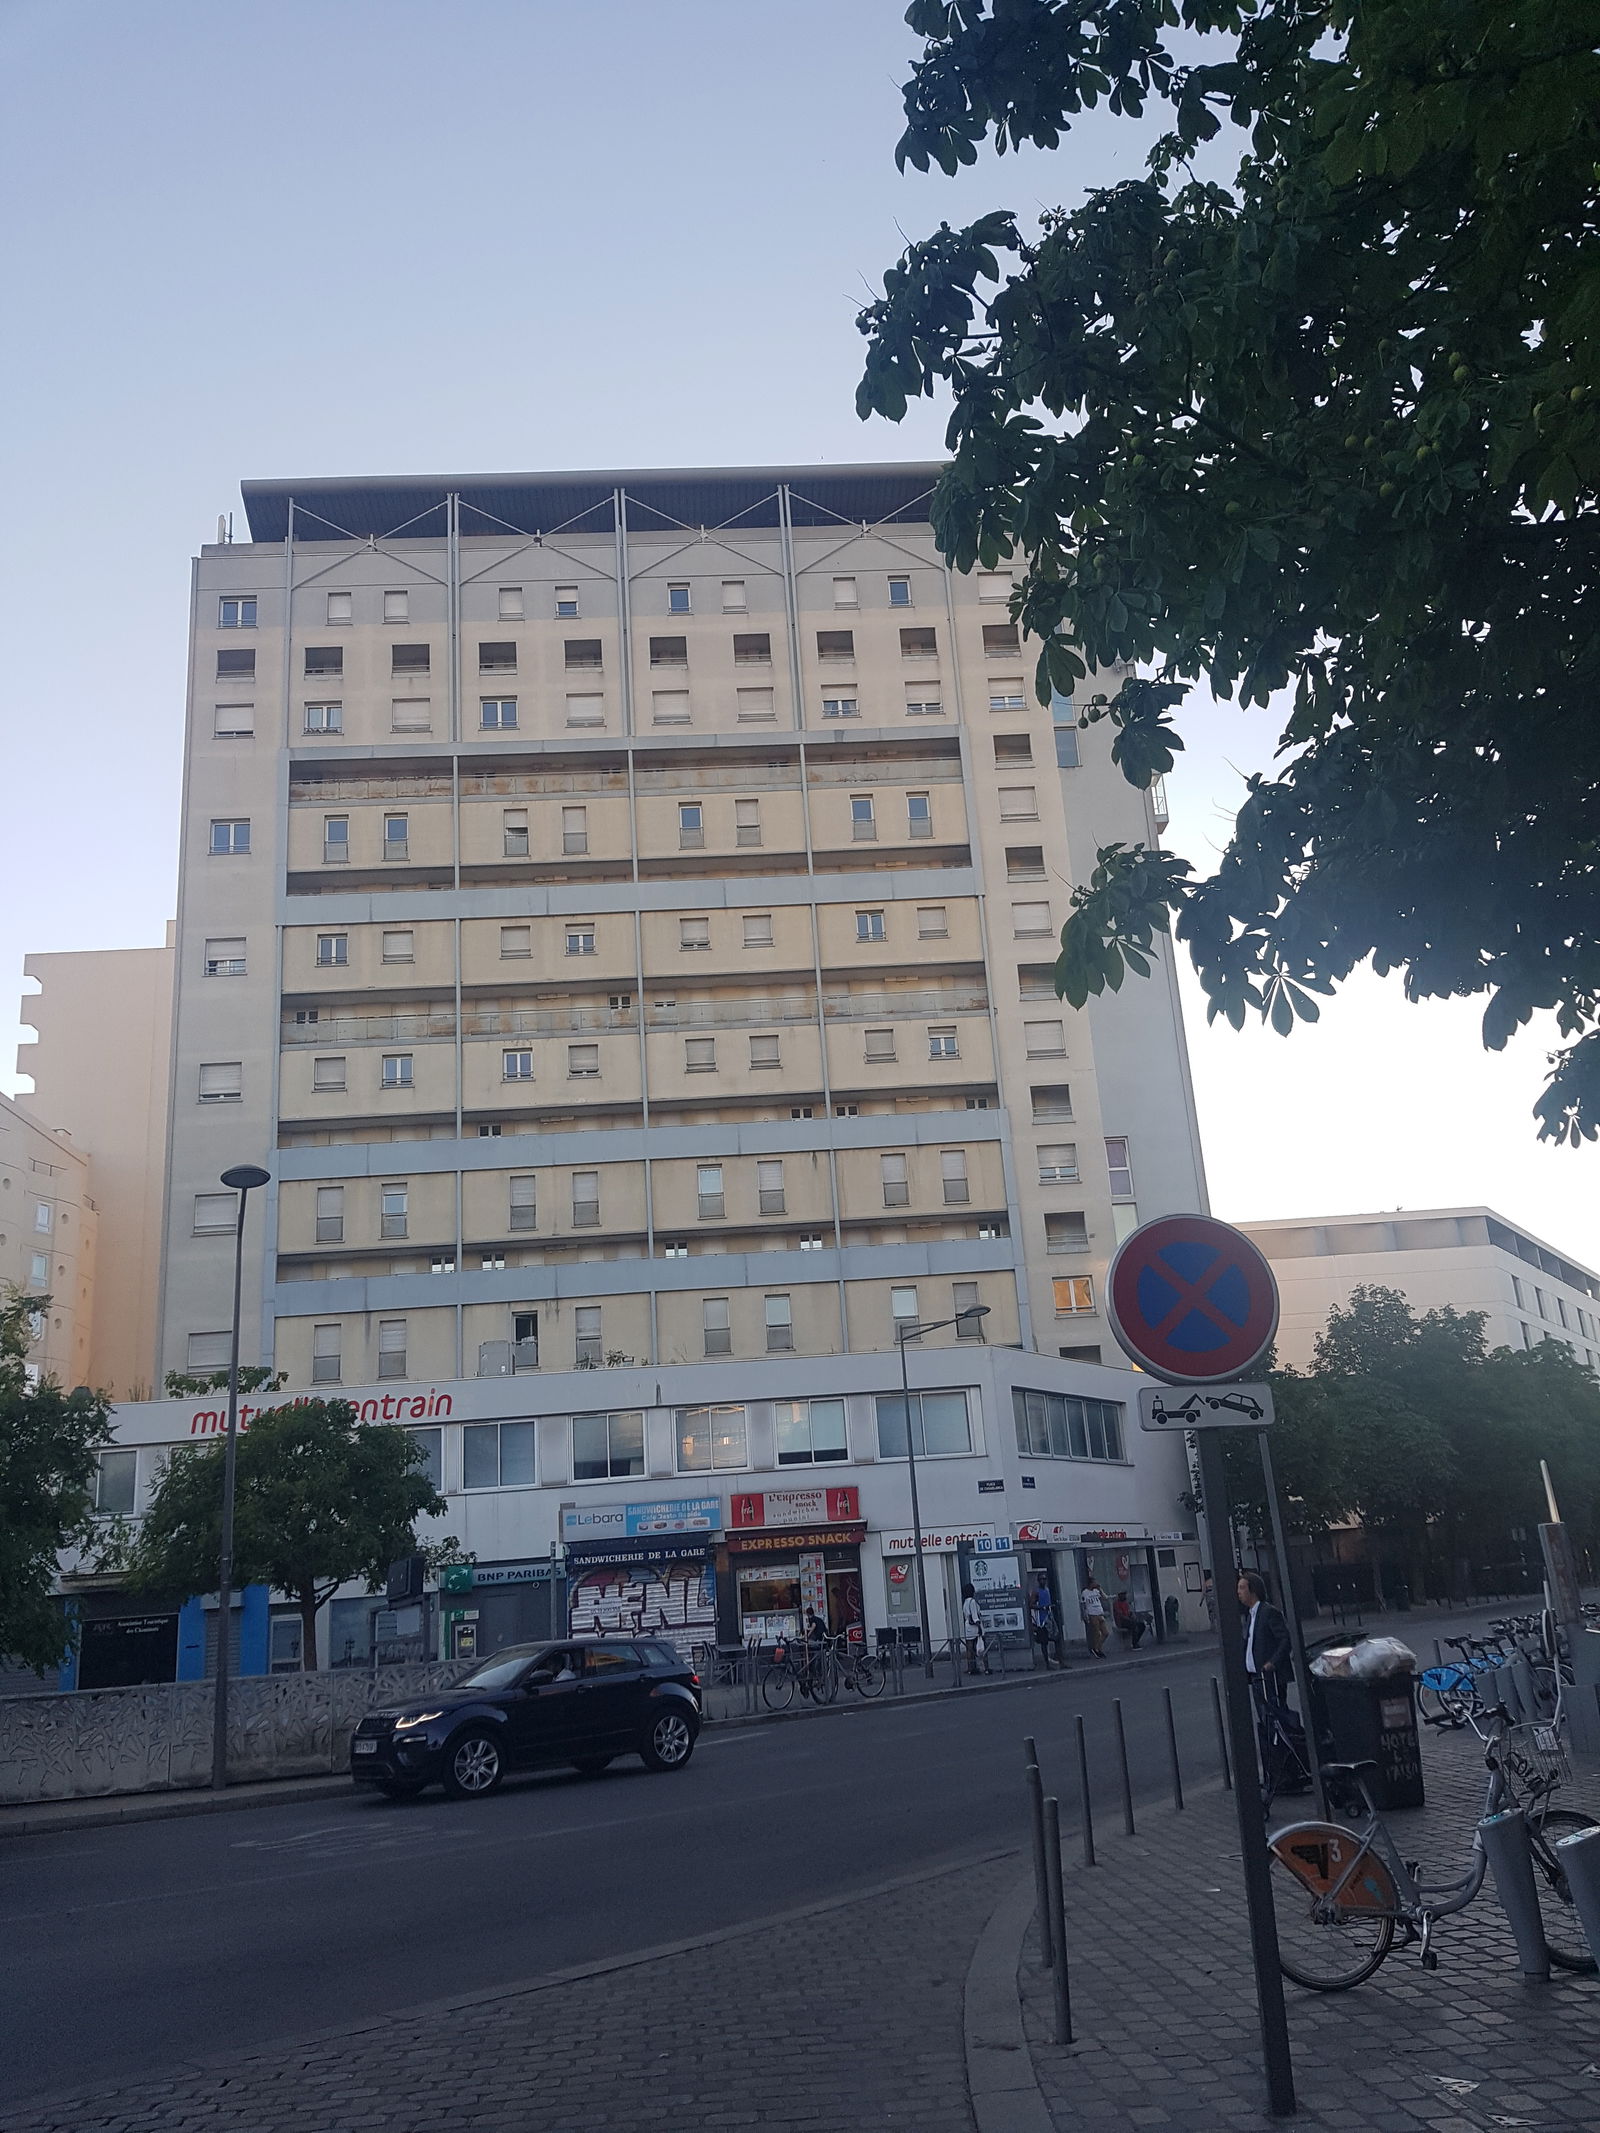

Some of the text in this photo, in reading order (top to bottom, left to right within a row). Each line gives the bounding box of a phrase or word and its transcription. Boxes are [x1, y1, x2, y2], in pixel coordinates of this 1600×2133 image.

[627, 1499, 719, 1516] SANDWICHERIE DE LA GARE
[795, 1499, 817, 1508] snack
[577, 1511, 624, 1526] Lebara
[773, 1506, 819, 1518] sandwiches
[741, 1532, 852, 1551] EXPRESSO SNACK
[888, 1533, 942, 1550] mutelle
[978, 1539, 991, 1551] 10
[996, 1538, 1009, 1549] 11
[573, 1547, 706, 1565] SANDWICHERIE DE LA GARE
[477, 1567, 561, 1582] BNP PARIBAS
